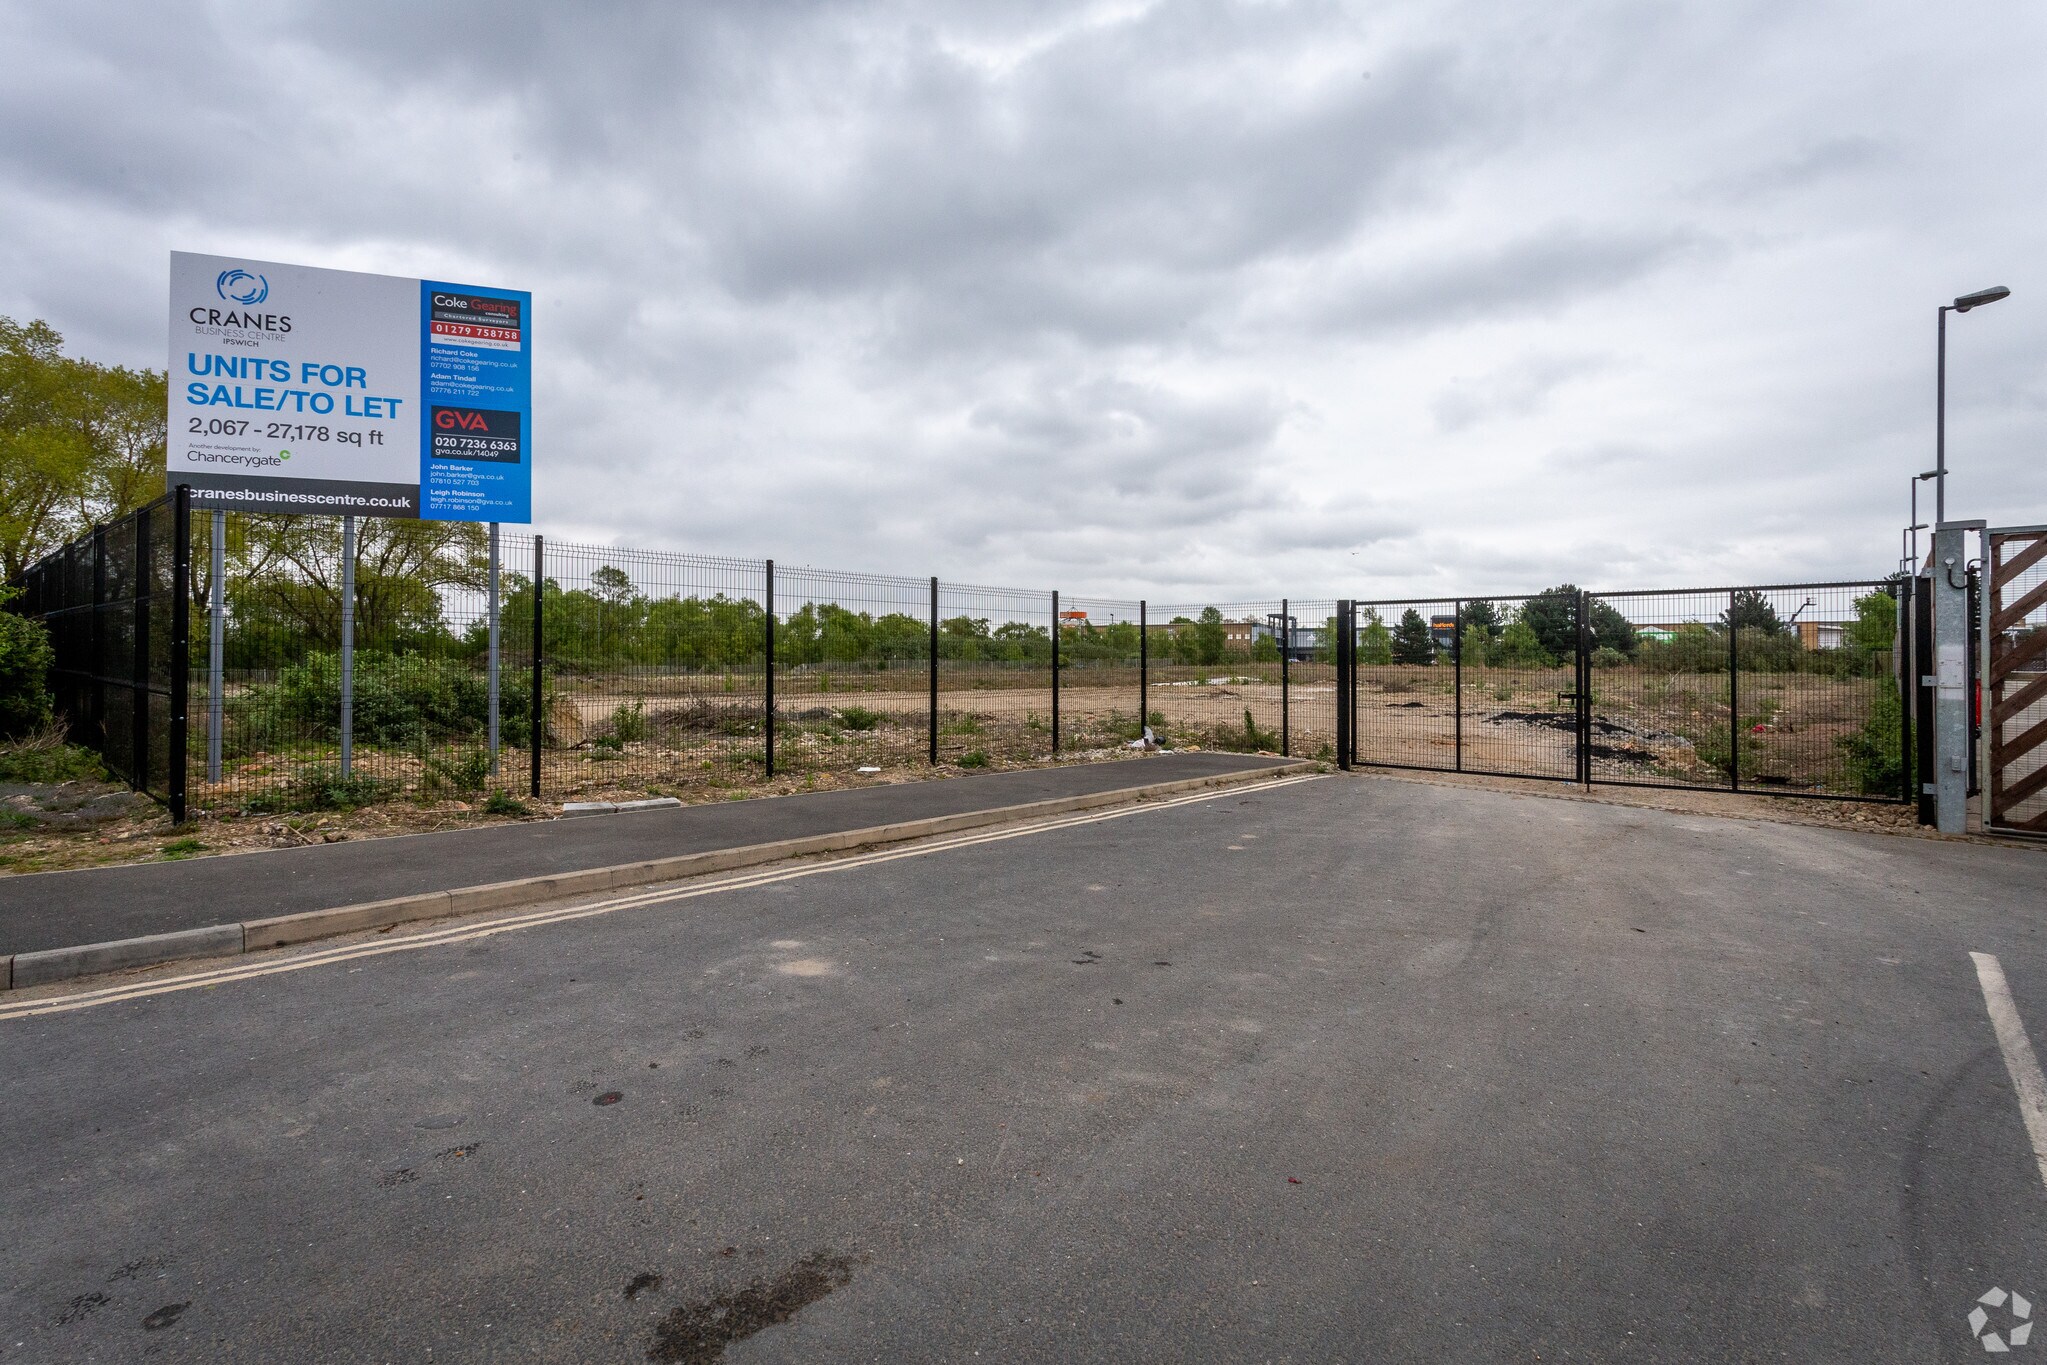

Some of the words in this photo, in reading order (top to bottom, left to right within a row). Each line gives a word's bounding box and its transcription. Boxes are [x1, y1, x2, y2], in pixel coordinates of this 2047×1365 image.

[434, 295, 468, 309] Coke
[470, 299, 518, 317] Gearing
[190, 307, 291, 333] CRANES
[443, 313, 476, 321] Chartered
[478, 316, 509, 325] Surveyors
[195, 325, 244, 339] BUSINESS
[247, 330, 285, 342] CENTRE
[436, 324, 472, 335] 01279
[476, 328, 518, 340] 758758
[223, 338, 259, 347] IPSWICH
[443, 337, 509, 348] www.cokegearing.co.uk
[430, 347, 458, 356] Richard
[459, 350, 479, 358] Coke
[430, 355, 518, 368] richard@cokegearing.co.uk
[188, 352, 290, 383] UNITS
[301, 362, 367, 389] FOR
[430, 372, 452, 380] Adam
[453, 374, 477, 382] Tindall
[430, 380, 514, 393] adam@cokegearing.co.uk
[186, 382, 334, 415] SALE/TO
[345, 395, 403, 420] LET
[435, 410, 489, 432] GVA
[188, 417, 249, 437] 2,067
[267, 422, 330, 443] 27,178
[336, 429, 362, 448] sq
[368, 429, 384, 446] ft
[213, 444, 251, 452] development
[435, 437, 457, 447] 020
[460, 438, 487, 449] 7236
[490, 441, 517, 451] 6363
[187, 450, 281, 467] Chancerygate
[435, 448, 499, 458] gva.co.uk/14049
[430, 471, 505, 481] john.barker@gva.co.uk
[190, 488, 411, 508] cranesbusinesscentre.co.uk
[430, 489, 451, 497] Leigh
[452, 490, 486, 498] Robinson
